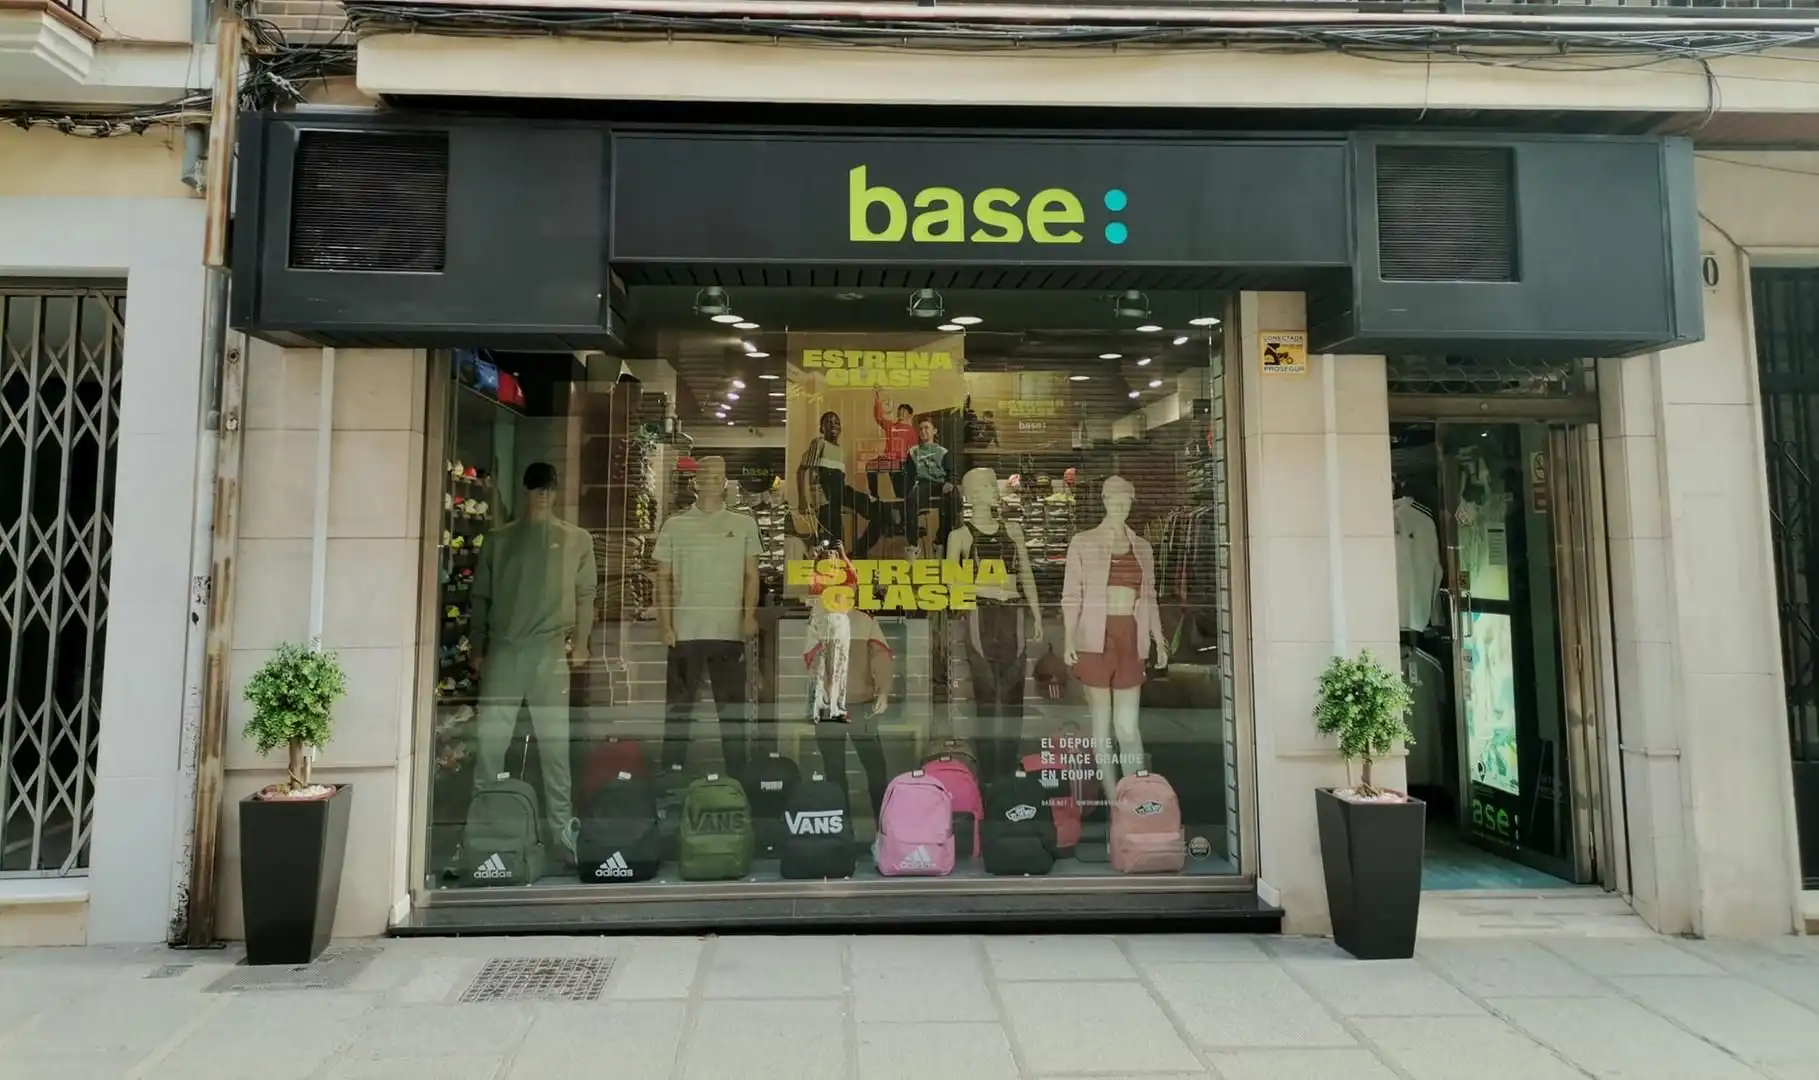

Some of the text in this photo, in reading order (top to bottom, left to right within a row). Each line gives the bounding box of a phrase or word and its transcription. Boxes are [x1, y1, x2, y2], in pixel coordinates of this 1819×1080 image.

[802, 349, 953, 370] ESTRENA
[825, 368, 930, 387] CLASE
[787, 559, 1010, 585] ESTRENA
[822, 585, 977, 613] CLASE
[1041, 738, 1112, 749] EL DEPORE
[1041, 753, 1056, 764] SE
[1060, 753, 1091, 764] HACE
[1041, 769, 1104, 780] EN EQUIPO
[688, 806, 745, 834] VANS
[785, 809, 843, 835] VANS
[473, 868, 513, 879] adidas
[594, 867, 634, 877] adidas
